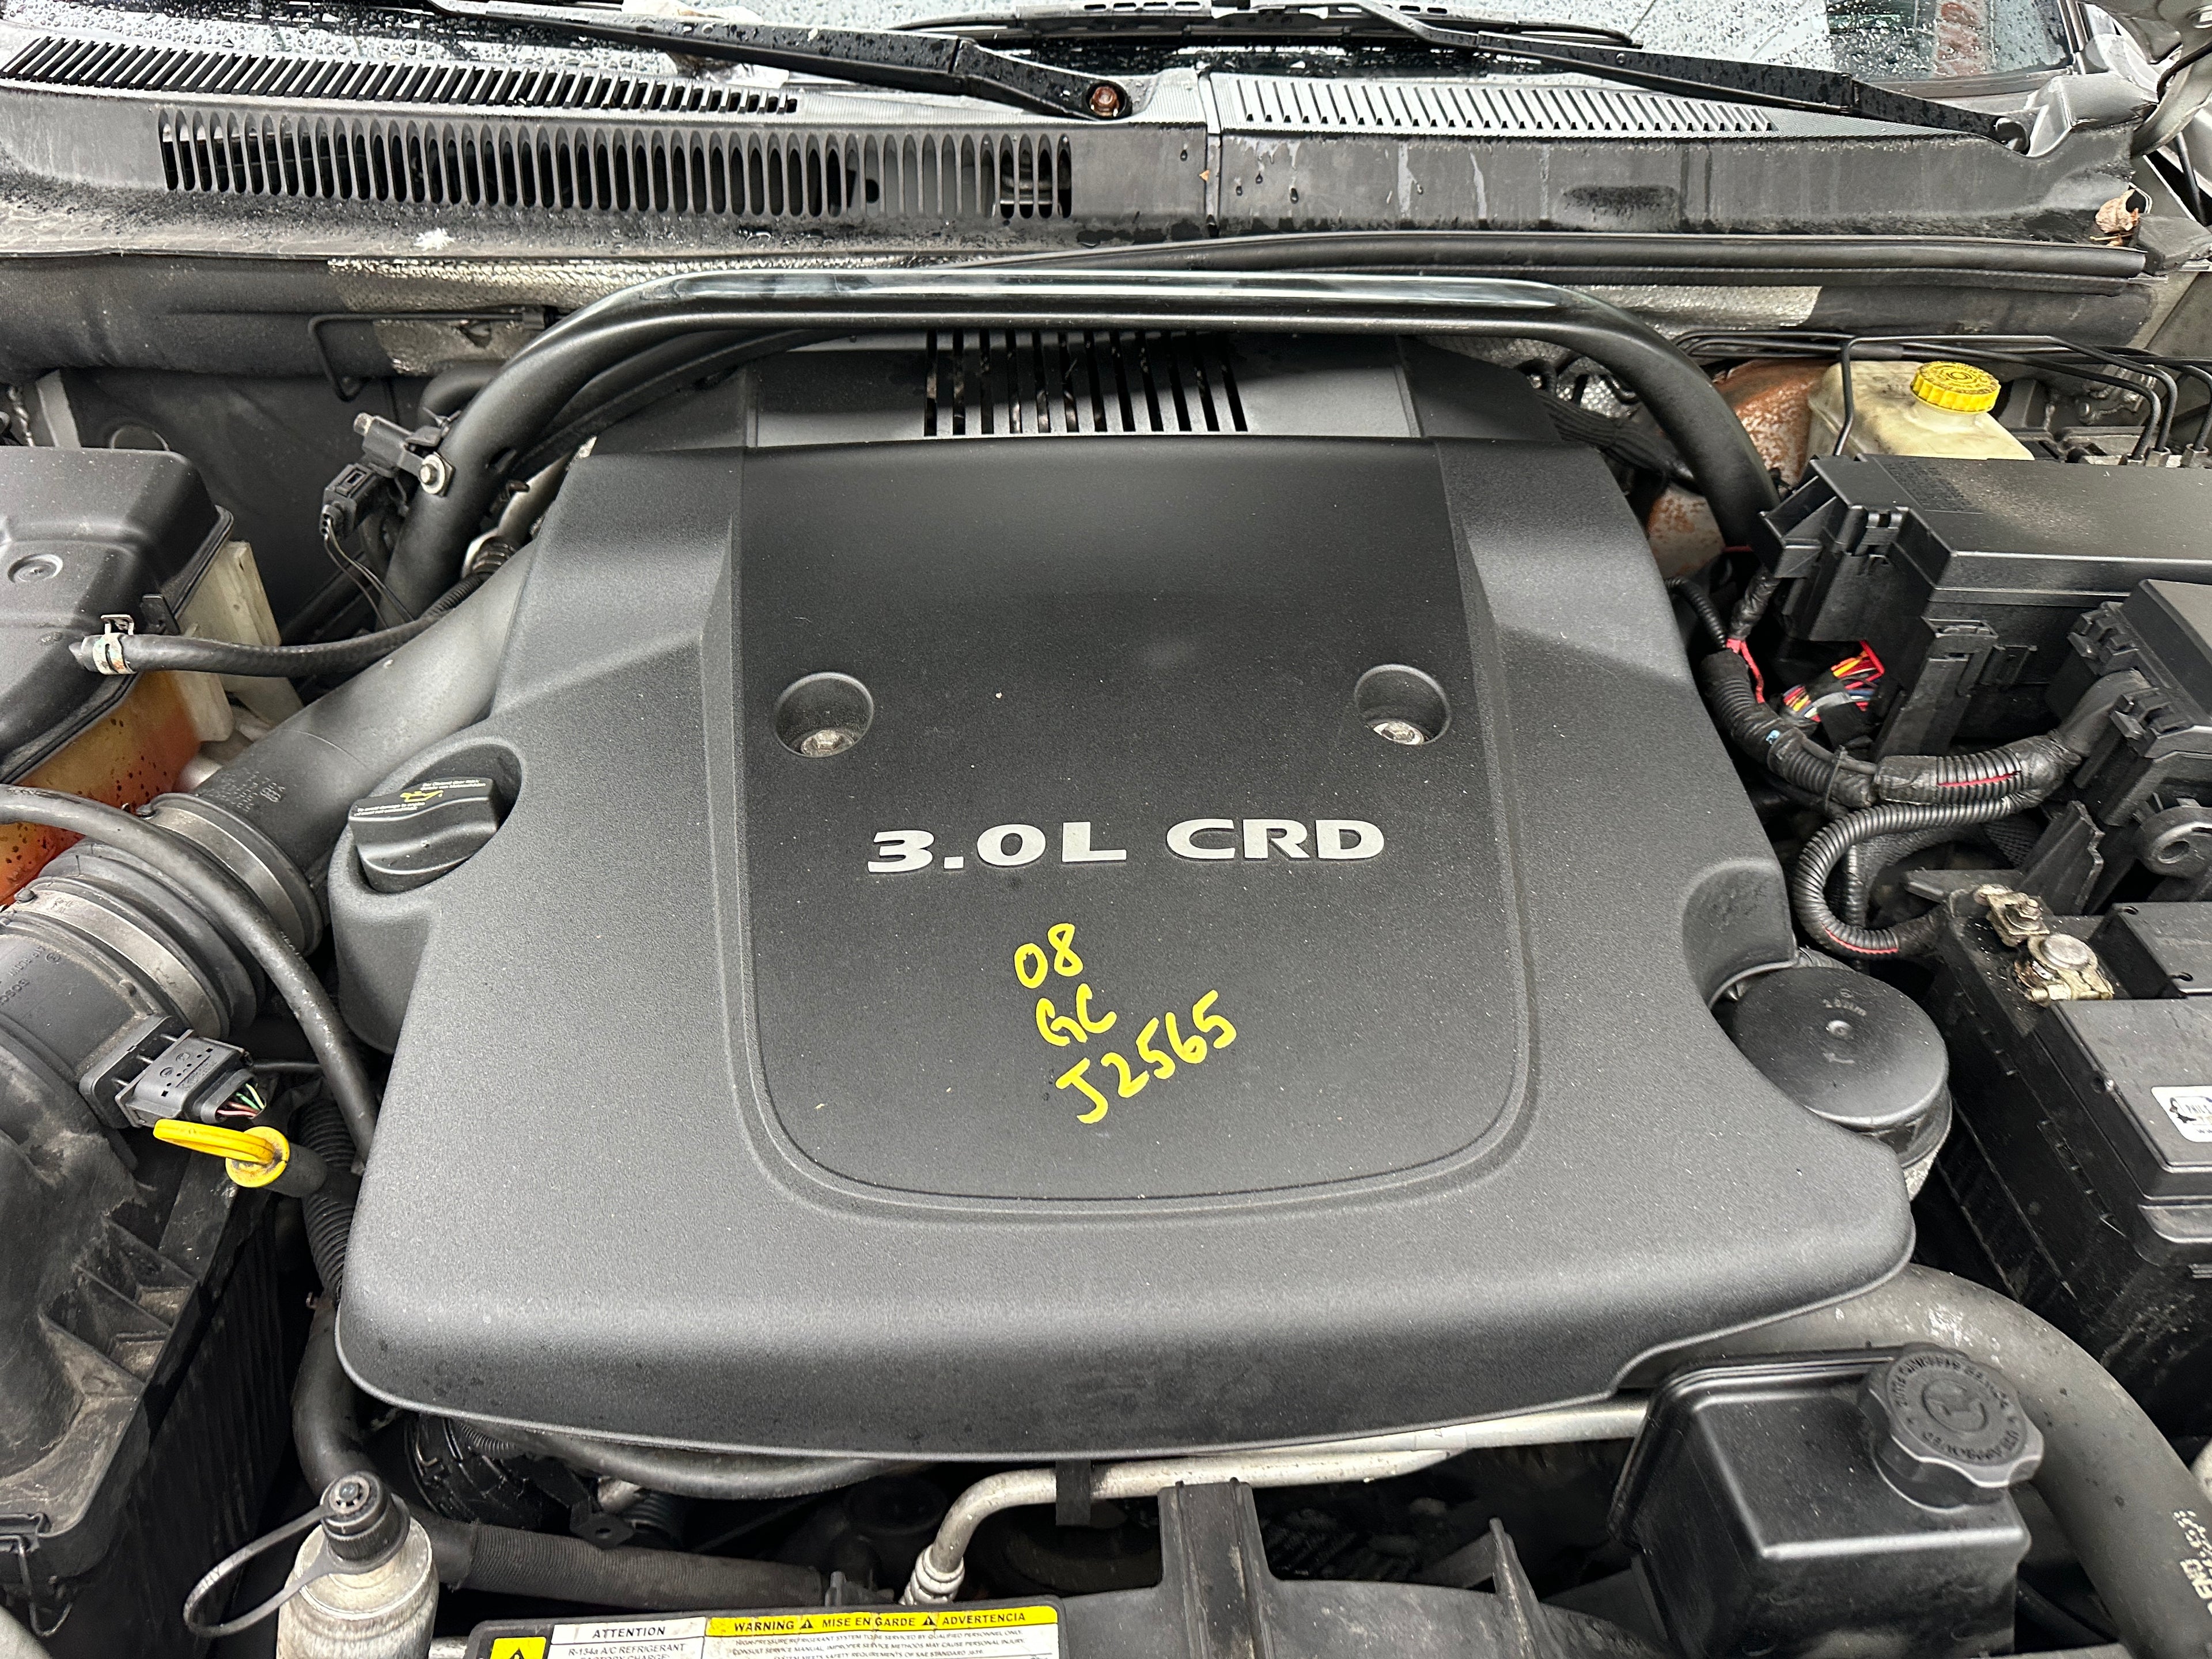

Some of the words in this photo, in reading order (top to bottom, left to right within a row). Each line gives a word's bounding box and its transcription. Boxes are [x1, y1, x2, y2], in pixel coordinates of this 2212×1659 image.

[867, 820, 1127, 873] 3.0L
[1166, 817, 1385, 861] CRD
[1014, 923, 1083, 988] 08
[1056, 990, 1237, 1123] J2565
[592, 1626, 666, 1639] ATTENTION
[734, 1620, 795, 1632] WARNING
[822, 1618, 851, 1628] MISE
[855, 1616, 871, 1627] EN
[874, 1616, 916, 1627] GARDE
[942, 1612, 1026, 1626] ADVERTENCIA
